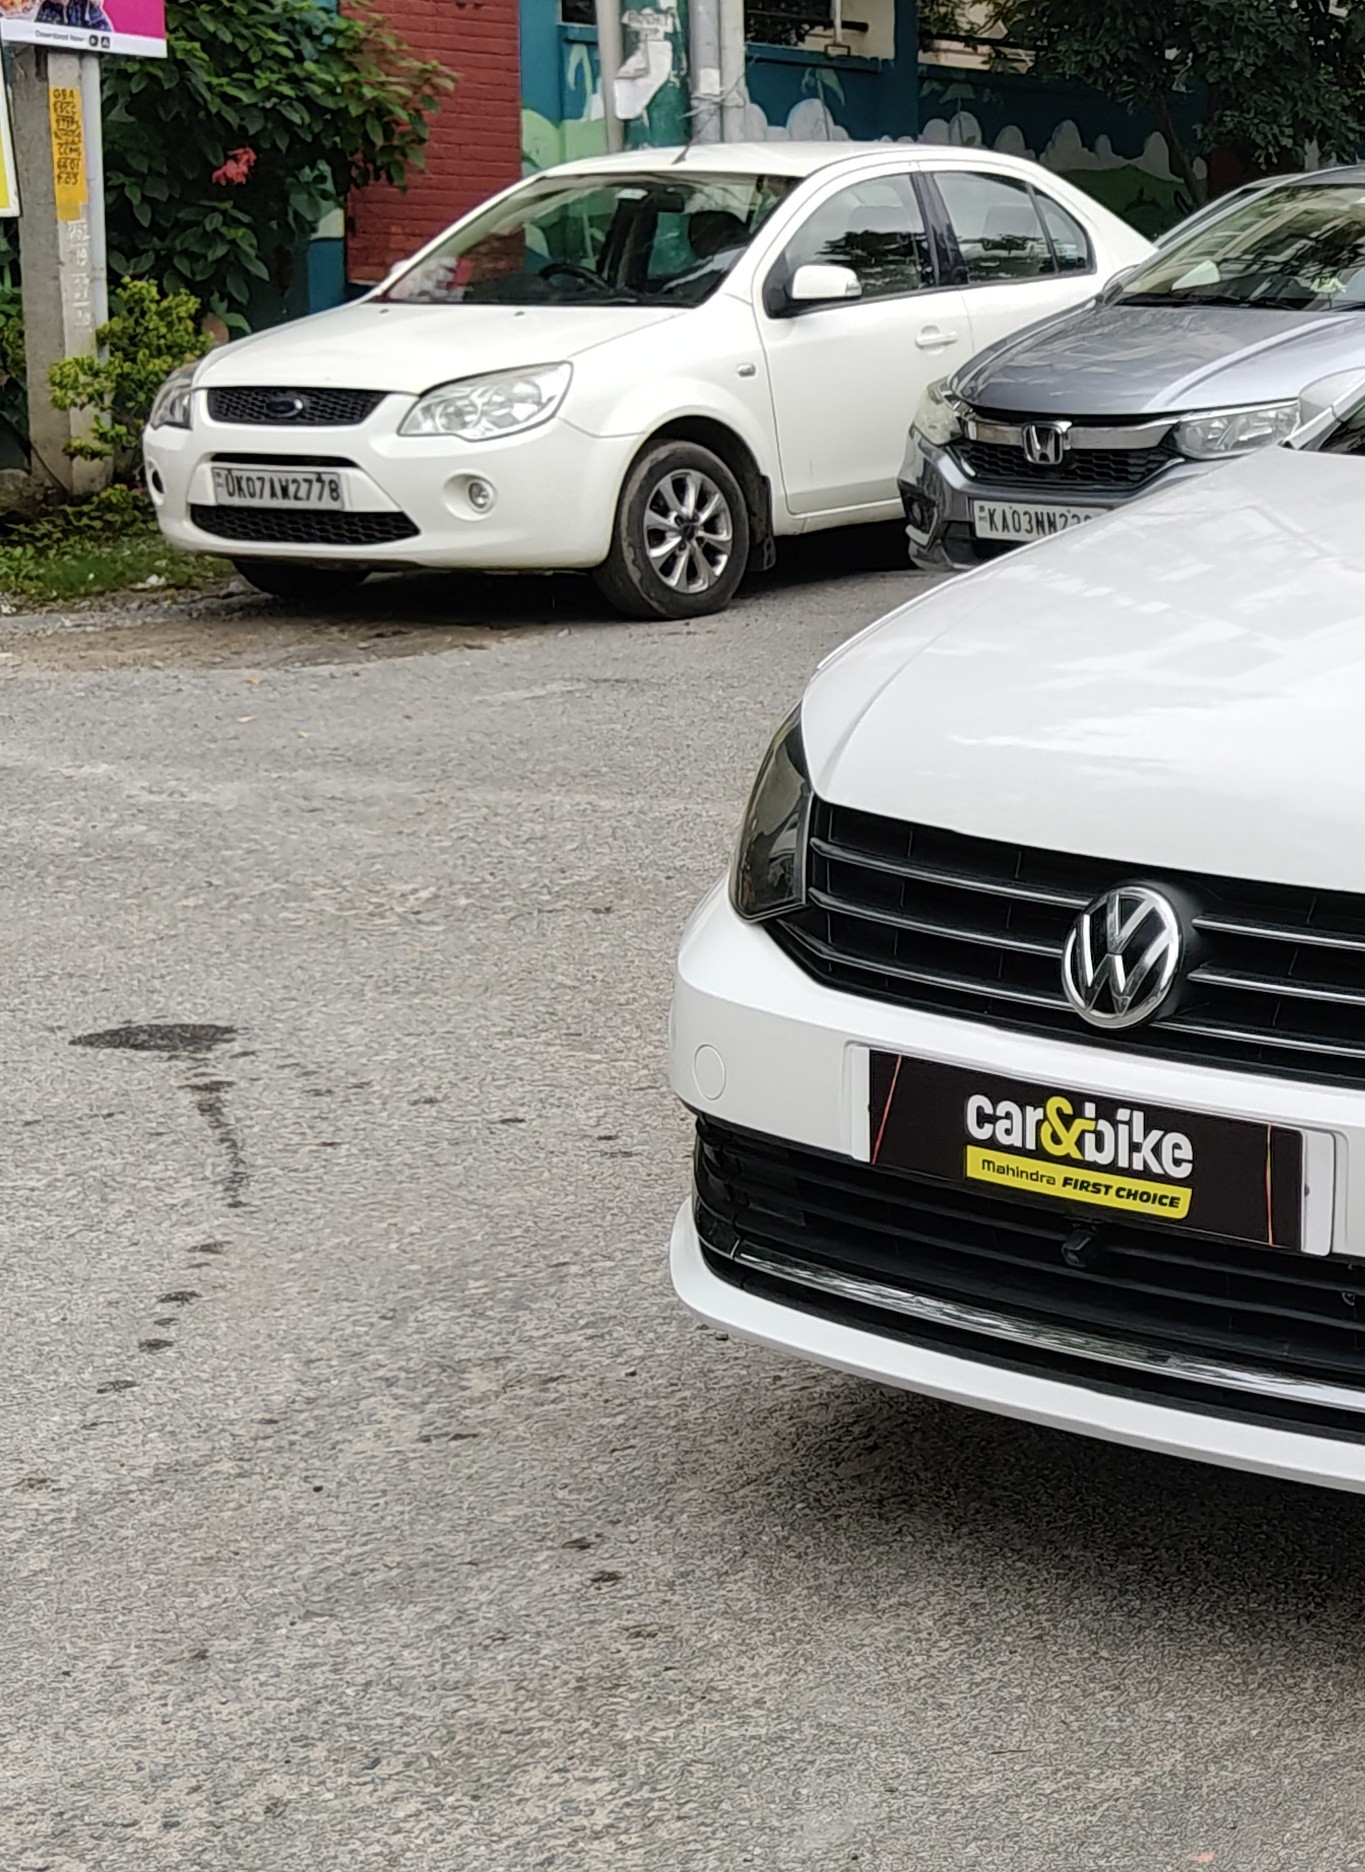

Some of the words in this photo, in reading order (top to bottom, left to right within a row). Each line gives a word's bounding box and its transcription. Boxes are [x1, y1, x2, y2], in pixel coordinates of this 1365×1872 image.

[966, 1094, 1193, 1179] car&bike
[1061, 1176, 1113, 1196] FIRST
[1115, 1186, 1181, 1209] CHOICE
